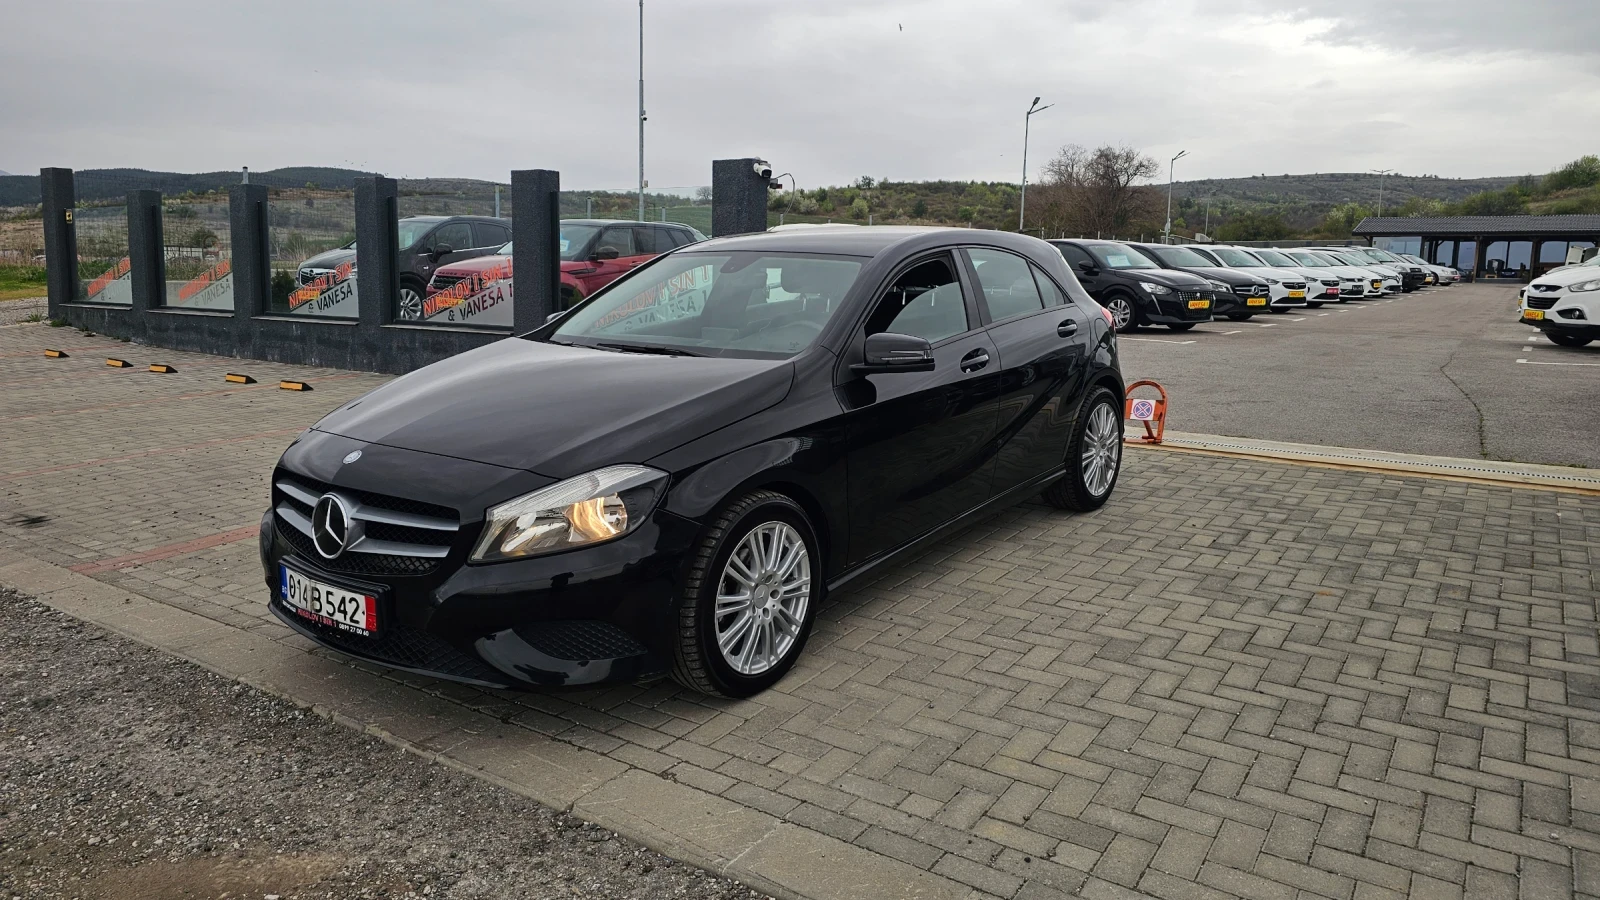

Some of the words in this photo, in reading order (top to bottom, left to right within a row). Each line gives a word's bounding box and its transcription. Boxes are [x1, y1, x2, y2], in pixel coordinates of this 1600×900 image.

[215, 258, 231, 280] SIN
[334, 260, 352, 283] SIN
[668, 269, 696, 297] SIN
[201, 282, 231, 306] VANESA
[316, 282, 353, 311] VANESA
[422, 277, 471, 319] NIKOLOV
[481, 264, 503, 289] SIN
[448, 309, 455, 322] &
[459, 286, 504, 321] VANESA
